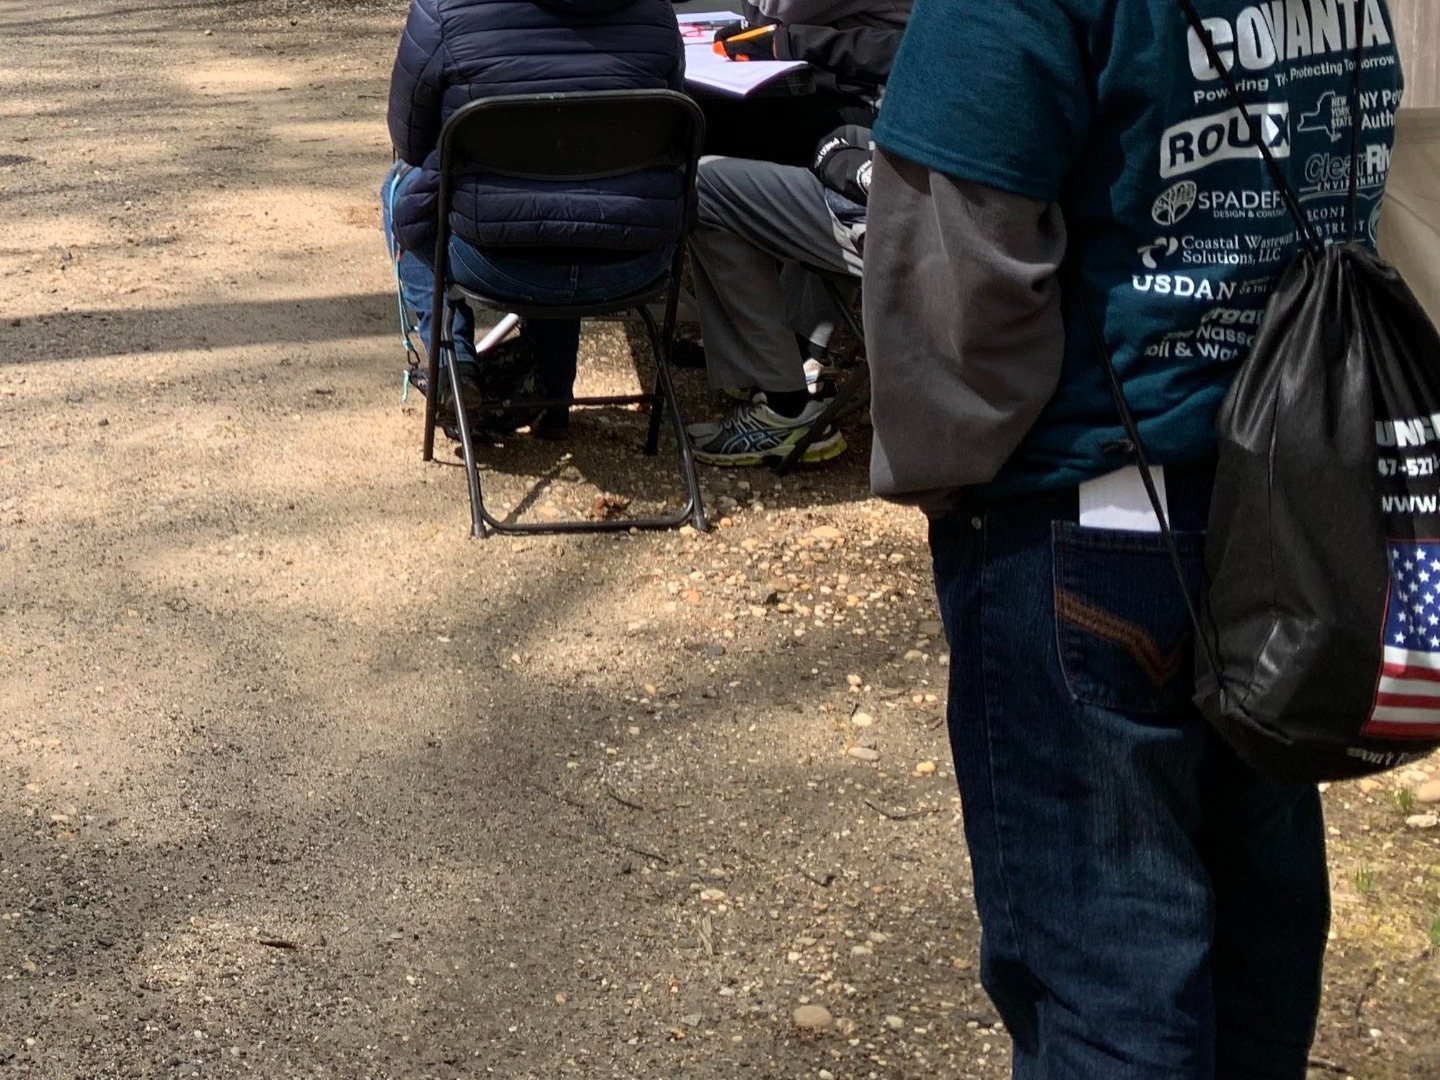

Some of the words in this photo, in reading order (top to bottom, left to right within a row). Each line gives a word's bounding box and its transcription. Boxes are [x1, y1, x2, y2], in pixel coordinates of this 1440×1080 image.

[1193, 78, 1269, 104] Powring
[1290, 61, 1343, 80] Protecting
[1360, 91, 1378, 110] NY
[1362, 110, 1395, 131] Auth
[1169, 113, 1290, 169] ROUX
[1213, 209, 1245, 219] DESIGN
[1248, 209, 1254, 218] &
[1181, 235, 1240, 250] Coastal
[1182, 250, 1256, 266] Solutions,
[1259, 248, 1281, 263] LLC
[1132, 274, 1237, 301] USDAN
[1174, 341, 1193, 357] &
[1382, 495, 1440, 513] WWW
